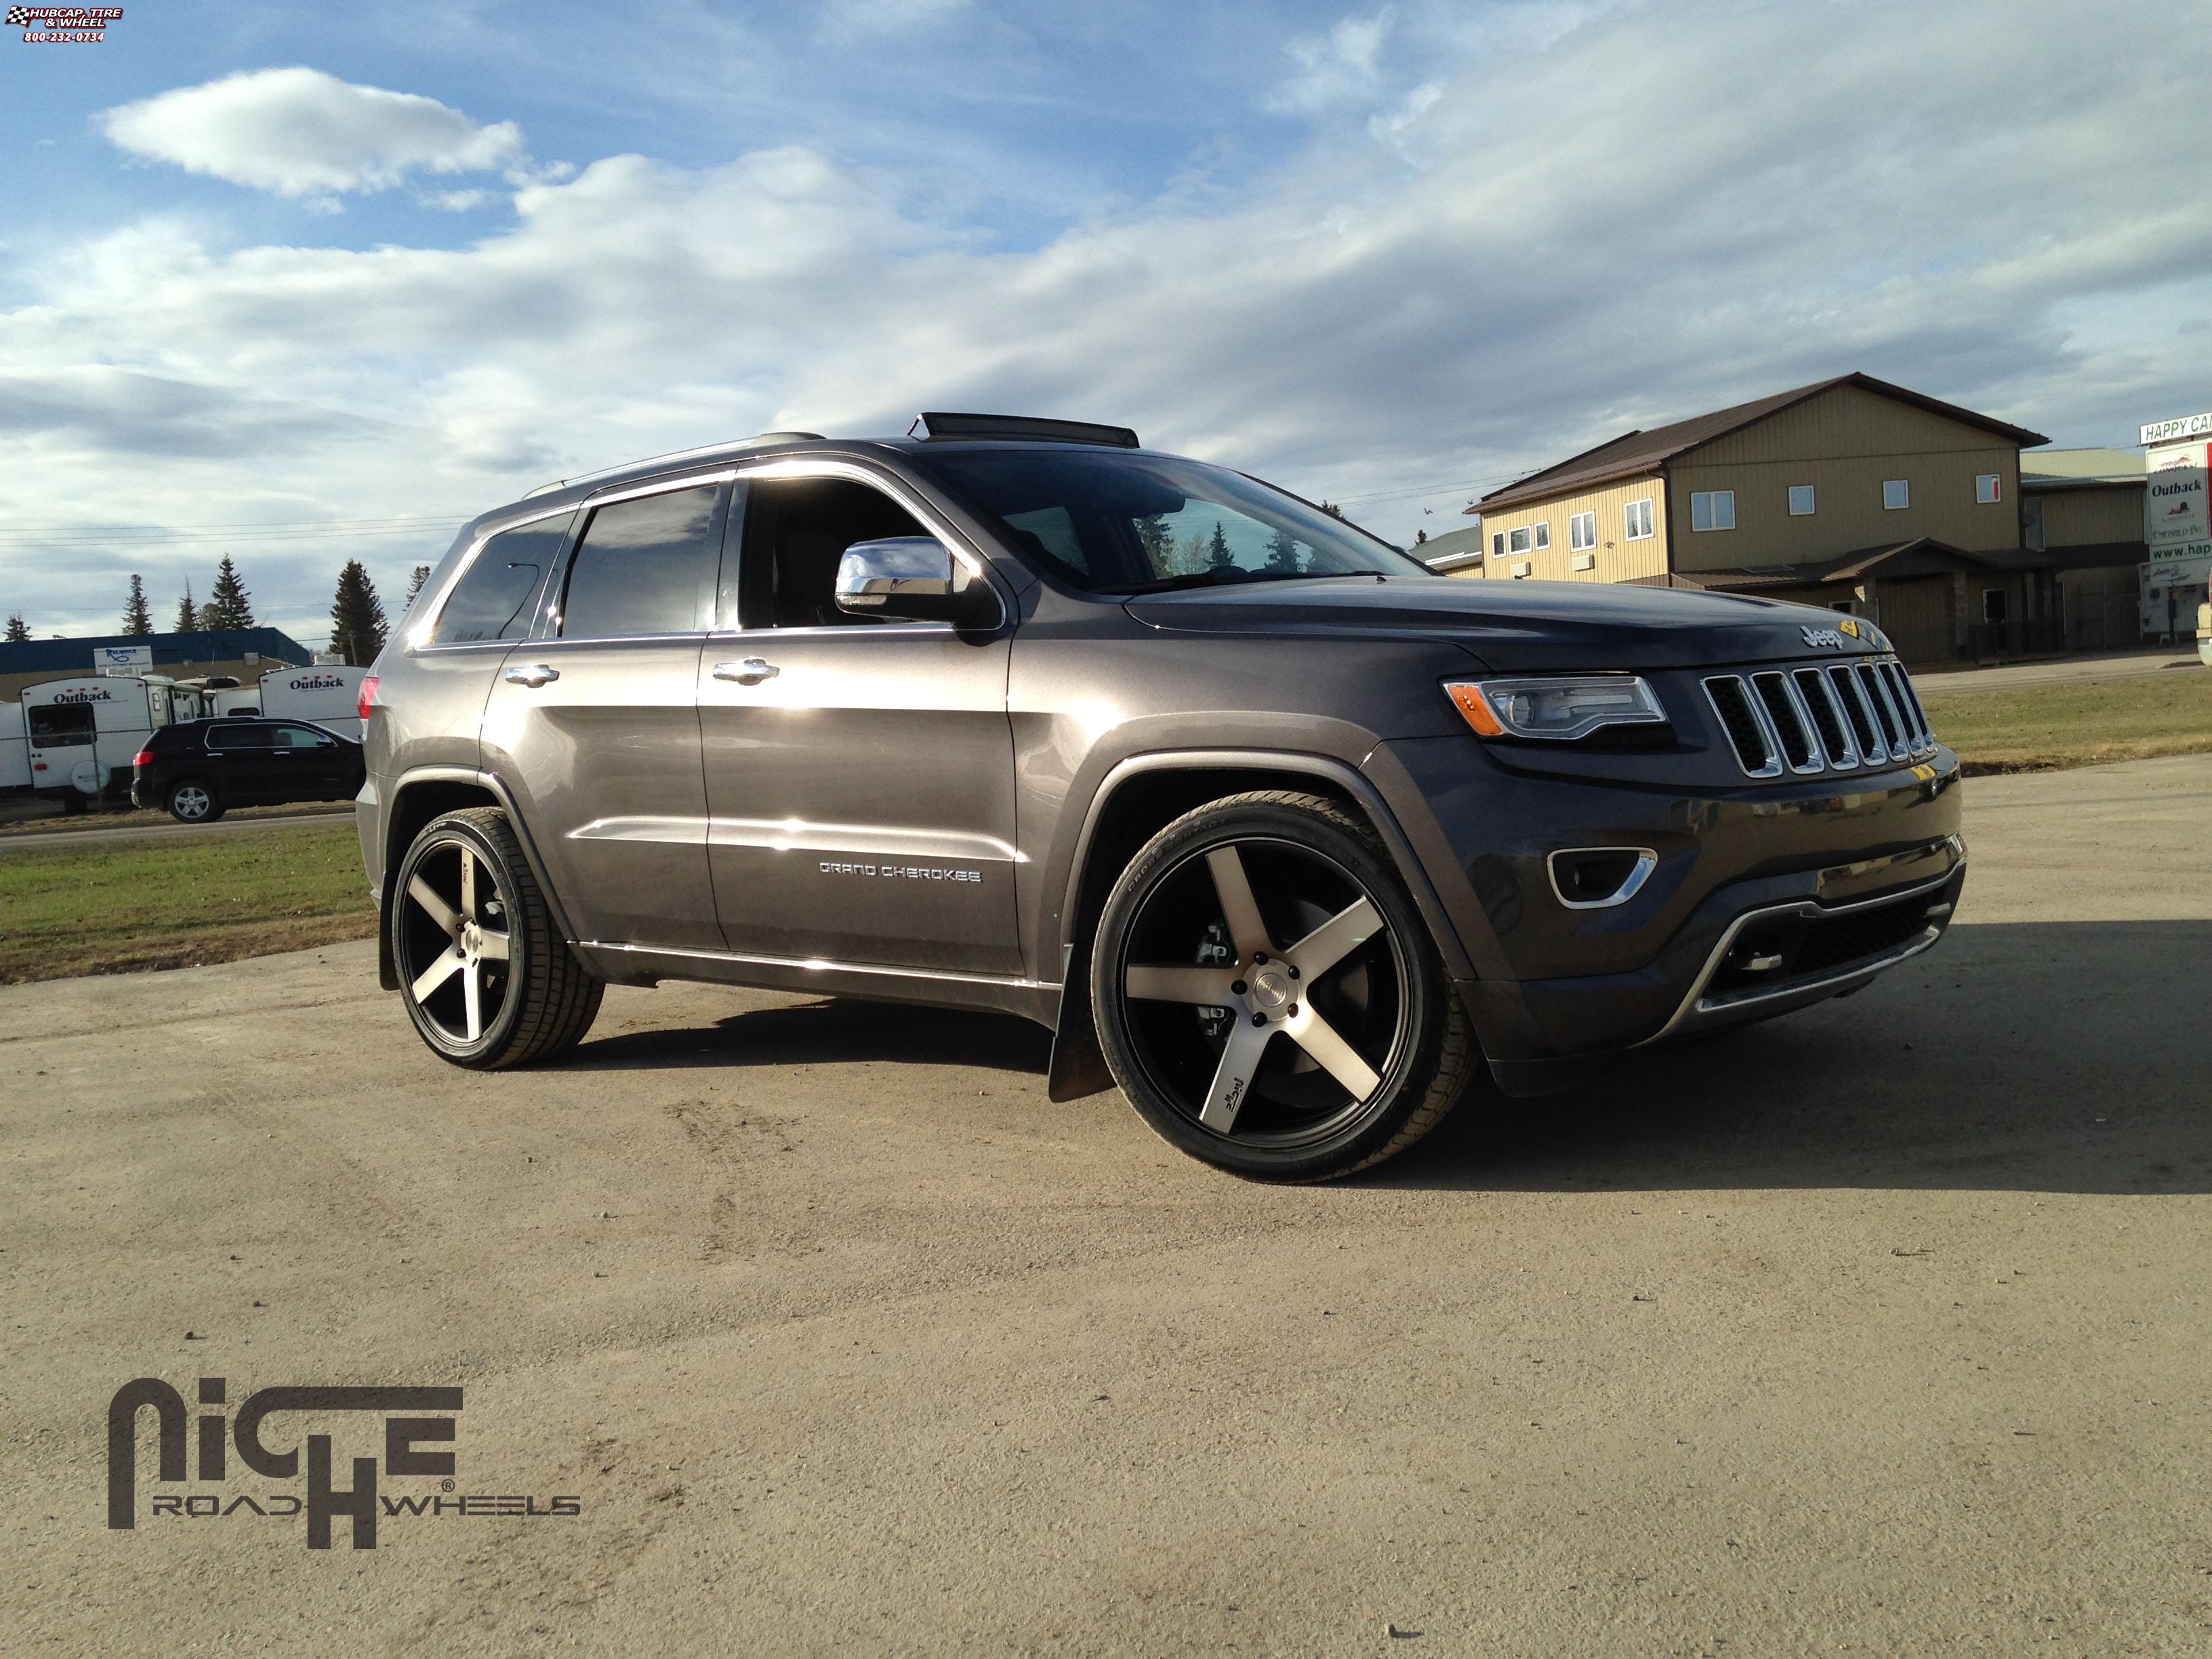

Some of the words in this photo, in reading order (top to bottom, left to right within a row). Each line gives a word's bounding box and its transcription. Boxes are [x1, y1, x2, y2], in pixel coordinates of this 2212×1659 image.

[2146, 419, 2187, 441] HAPPY
[2152, 479, 2202, 497] Outback
[1800, 626, 1843, 650] Jeep
[290, 678, 344, 690] Outback
[54, 690, 112, 703] Outback
[819, 862, 878, 876] GRAND
[881, 866, 983, 882] CHEROKEE
